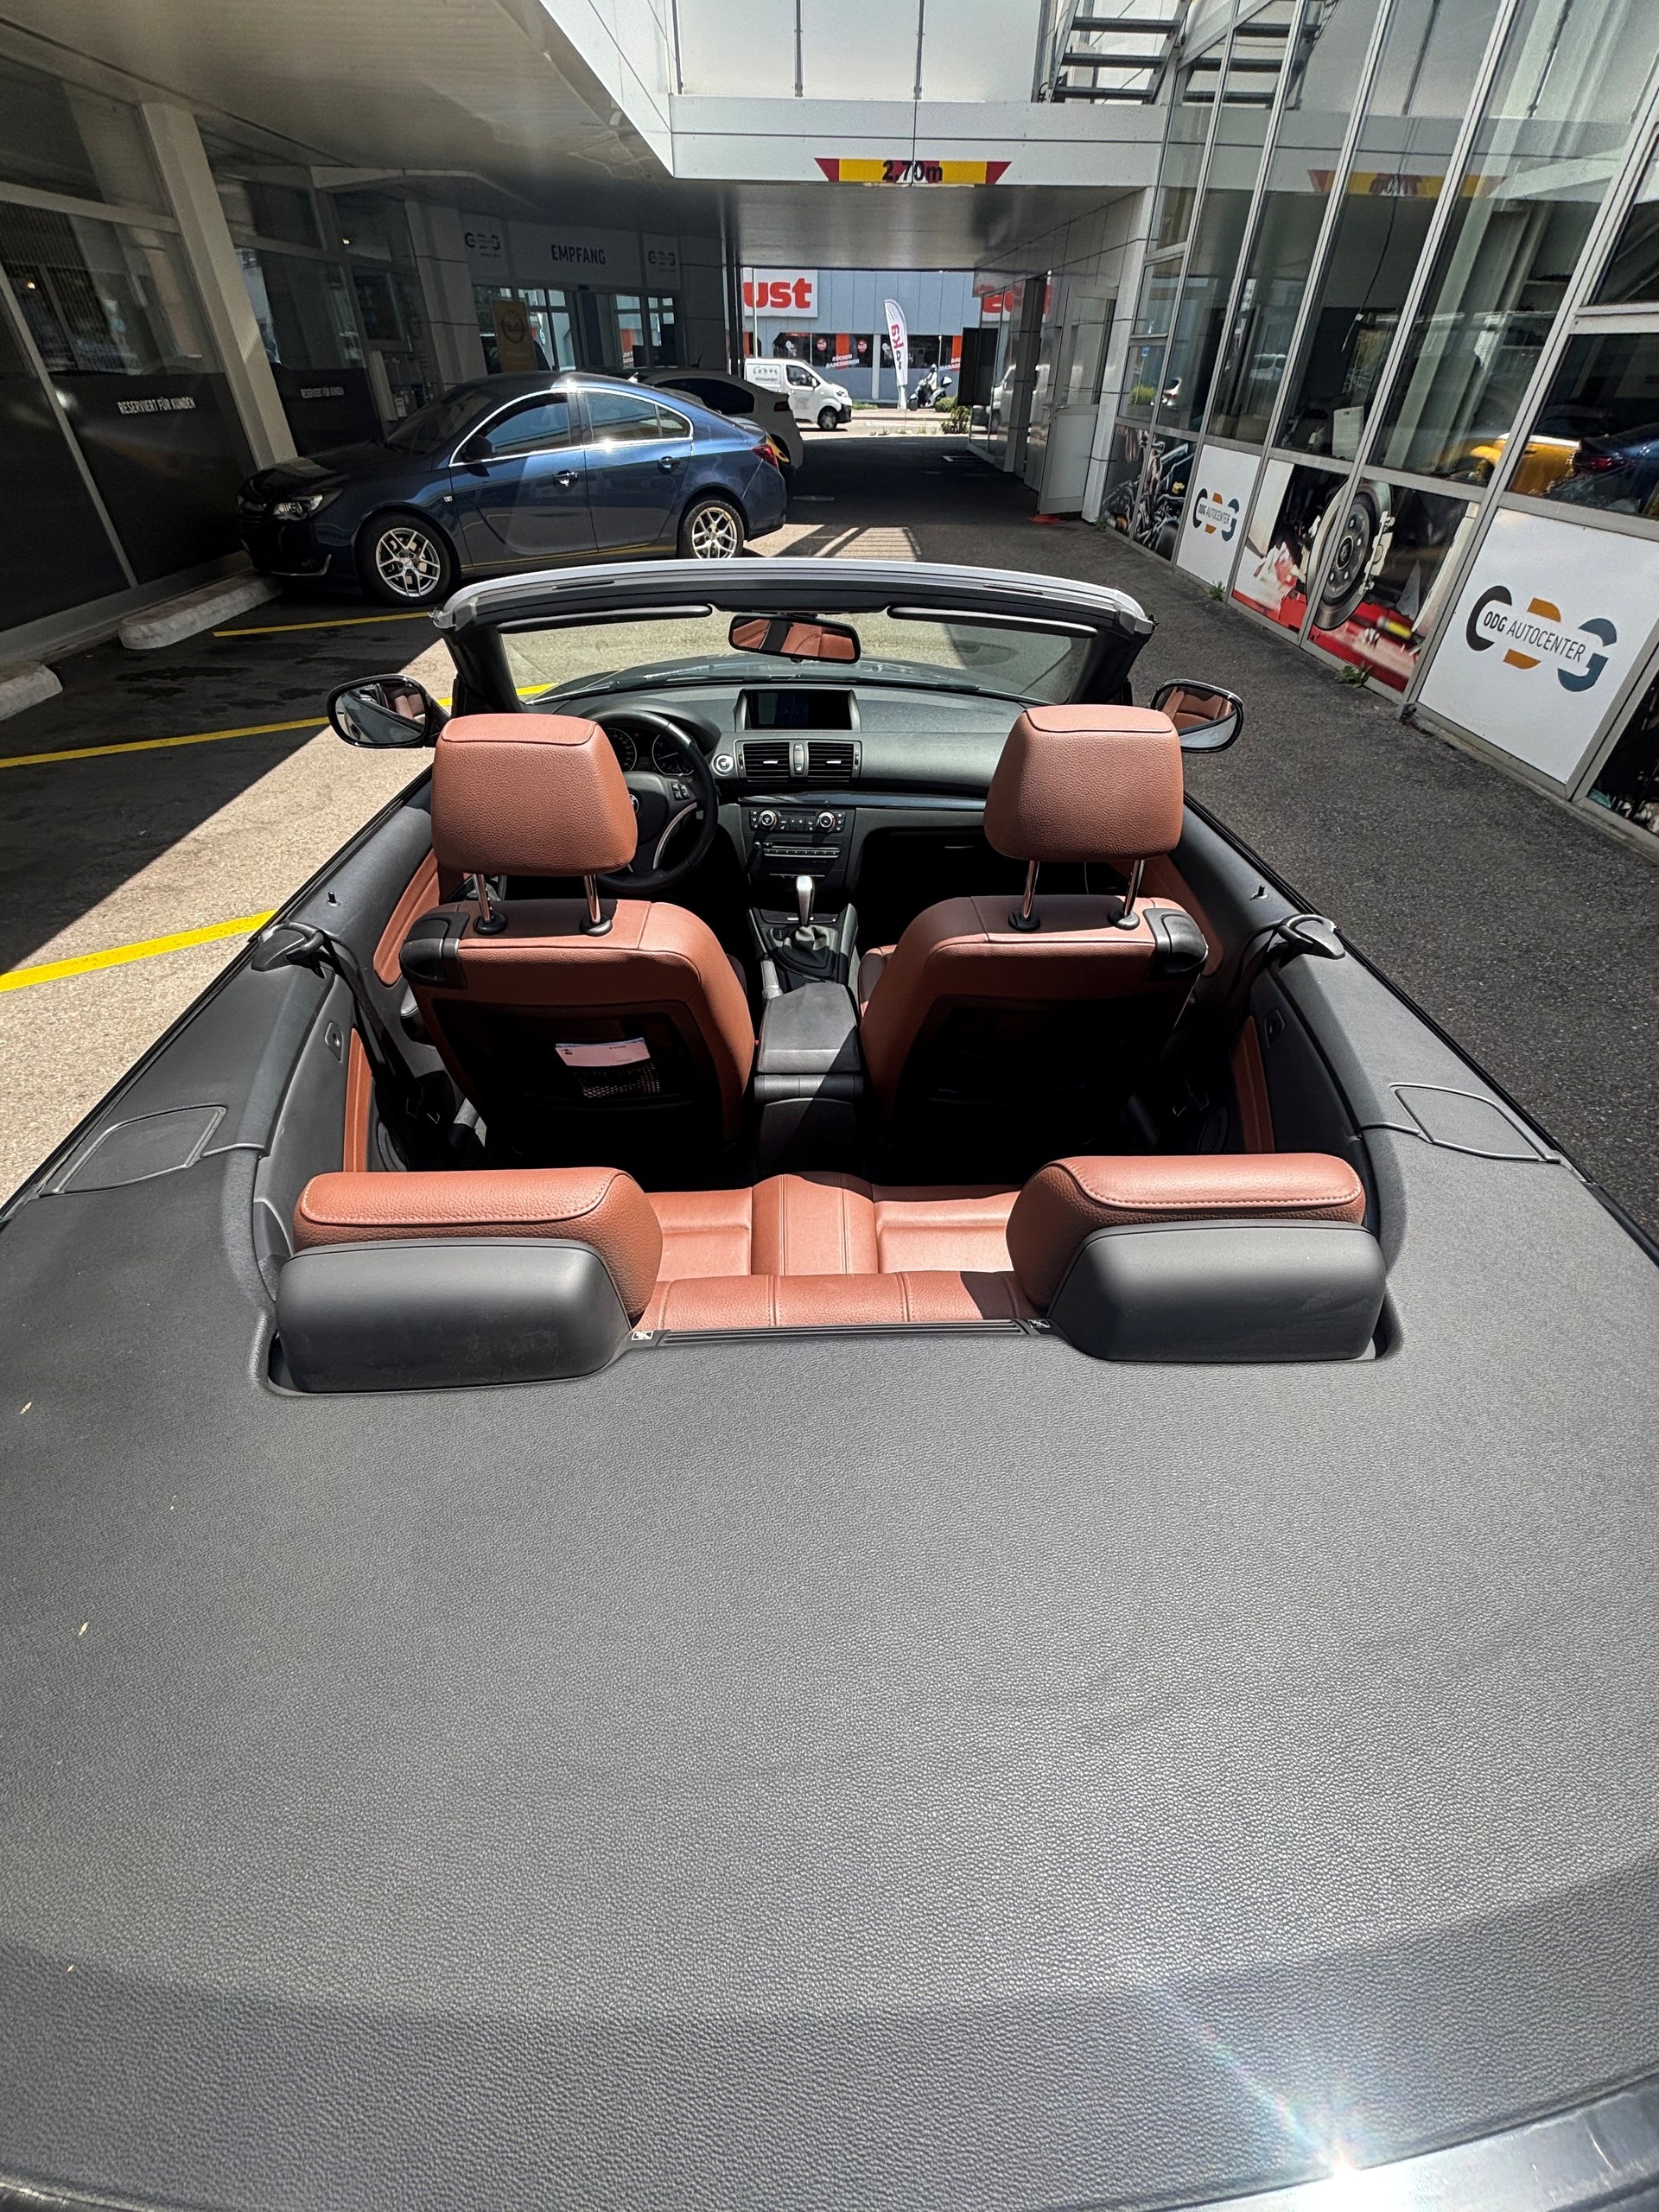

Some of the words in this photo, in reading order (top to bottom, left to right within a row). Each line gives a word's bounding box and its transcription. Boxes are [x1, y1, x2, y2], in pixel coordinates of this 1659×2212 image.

[550, 244, 607, 265] EMPFANG
[118, 399, 158, 415] RESERVIERT
[156, 397, 172, 411] FÜR
[170, 397, 196, 410] KUNDEN
[1483, 611, 1508, 632] ODG
[1506, 620, 1586, 662] AUTOCENTER
